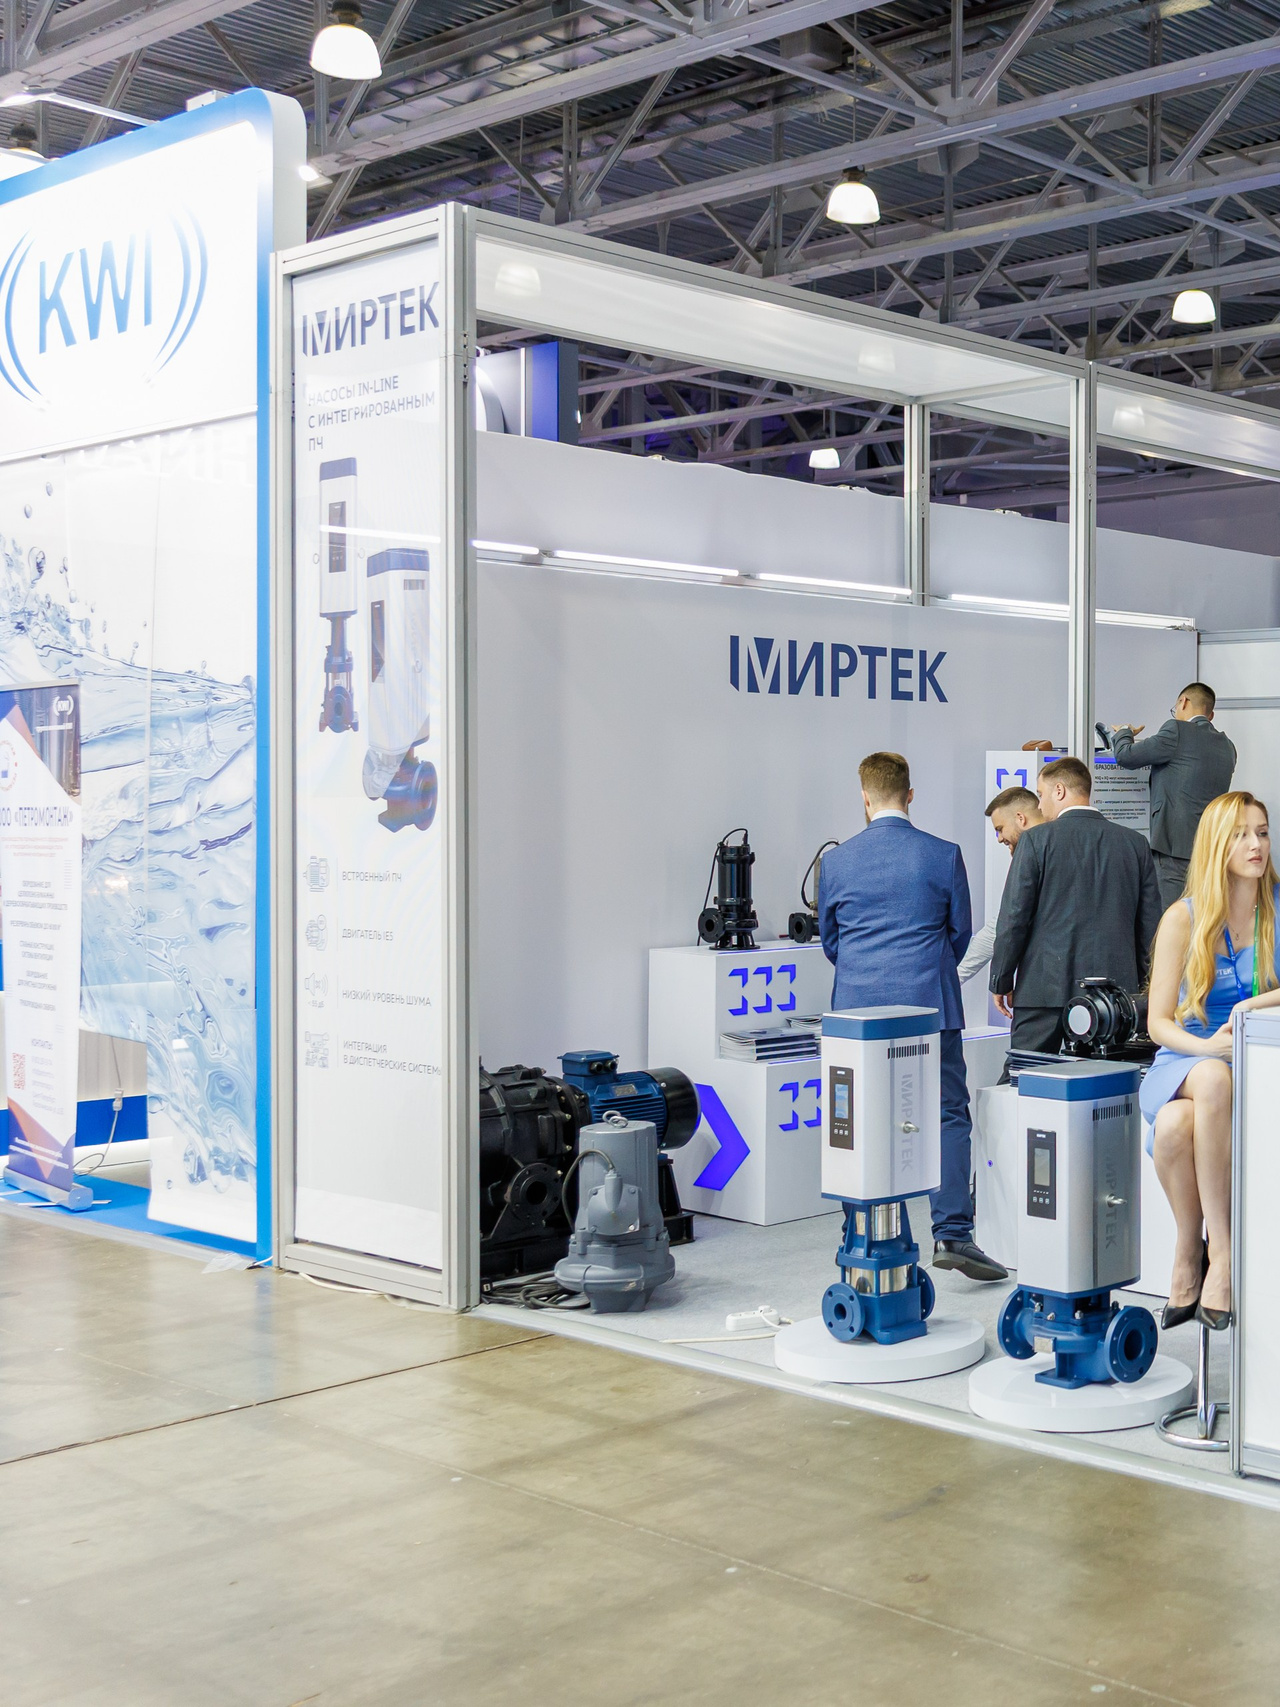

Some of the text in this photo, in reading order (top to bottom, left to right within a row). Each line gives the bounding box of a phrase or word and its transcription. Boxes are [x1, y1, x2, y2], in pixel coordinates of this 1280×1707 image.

[38, 228, 153, 354] KWI
[302, 281, 440, 358] МИРТЕК
[308, 375, 399, 407] НАСОСЫ IN-LINE
[308, 391, 436, 429] С ИНТЕГРИРОВАННЫМ
[308, 436, 324, 451] ПЧ
[730, 635, 949, 703] МИРТЕК
[0, 807, 12, 827] ОО
[342, 871, 402, 883] ВСТРОЕННЫЙ ПЧ
[342, 928, 382, 941] ДВИГАТЕЛЬ
[342, 989, 432, 1007] НИЗКИЙ УРОВЕНЬ ШУМА
[343, 1040, 387, 1054] ИНТЕГРАЦИЯ
[343, 1056, 349, 1065] В
[349, 1057, 406, 1073] ДИСПЕТЧЕРСКИЕ
